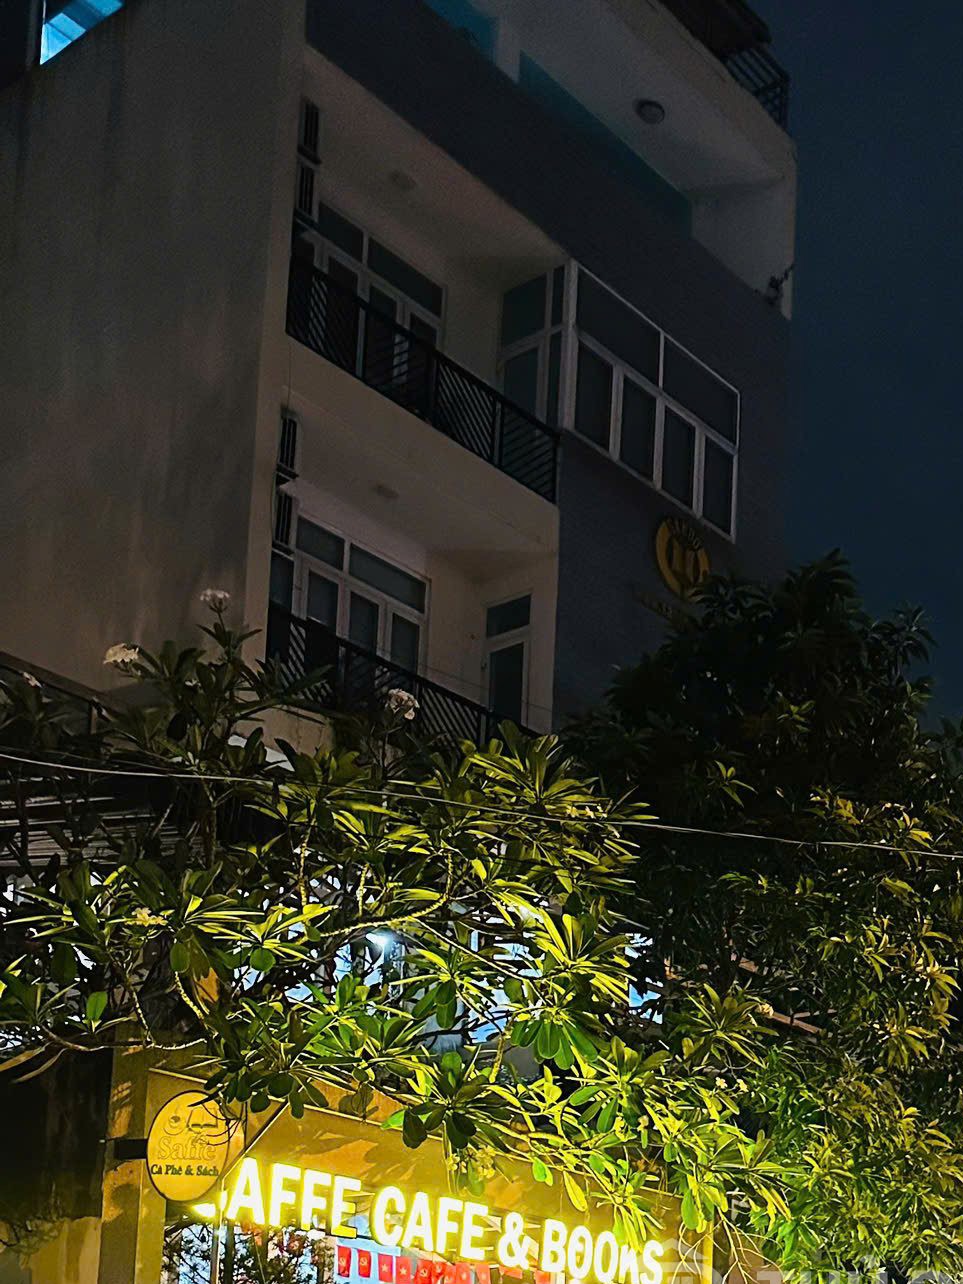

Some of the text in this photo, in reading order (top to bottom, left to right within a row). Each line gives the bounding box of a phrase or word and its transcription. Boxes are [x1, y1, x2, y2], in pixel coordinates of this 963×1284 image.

[185, 1164, 194, 1176] &
[194, 1156, 362, 1239] AFFE
[372, 1185, 489, 1261] CAFE
[498, 1211, 532, 1271] &
